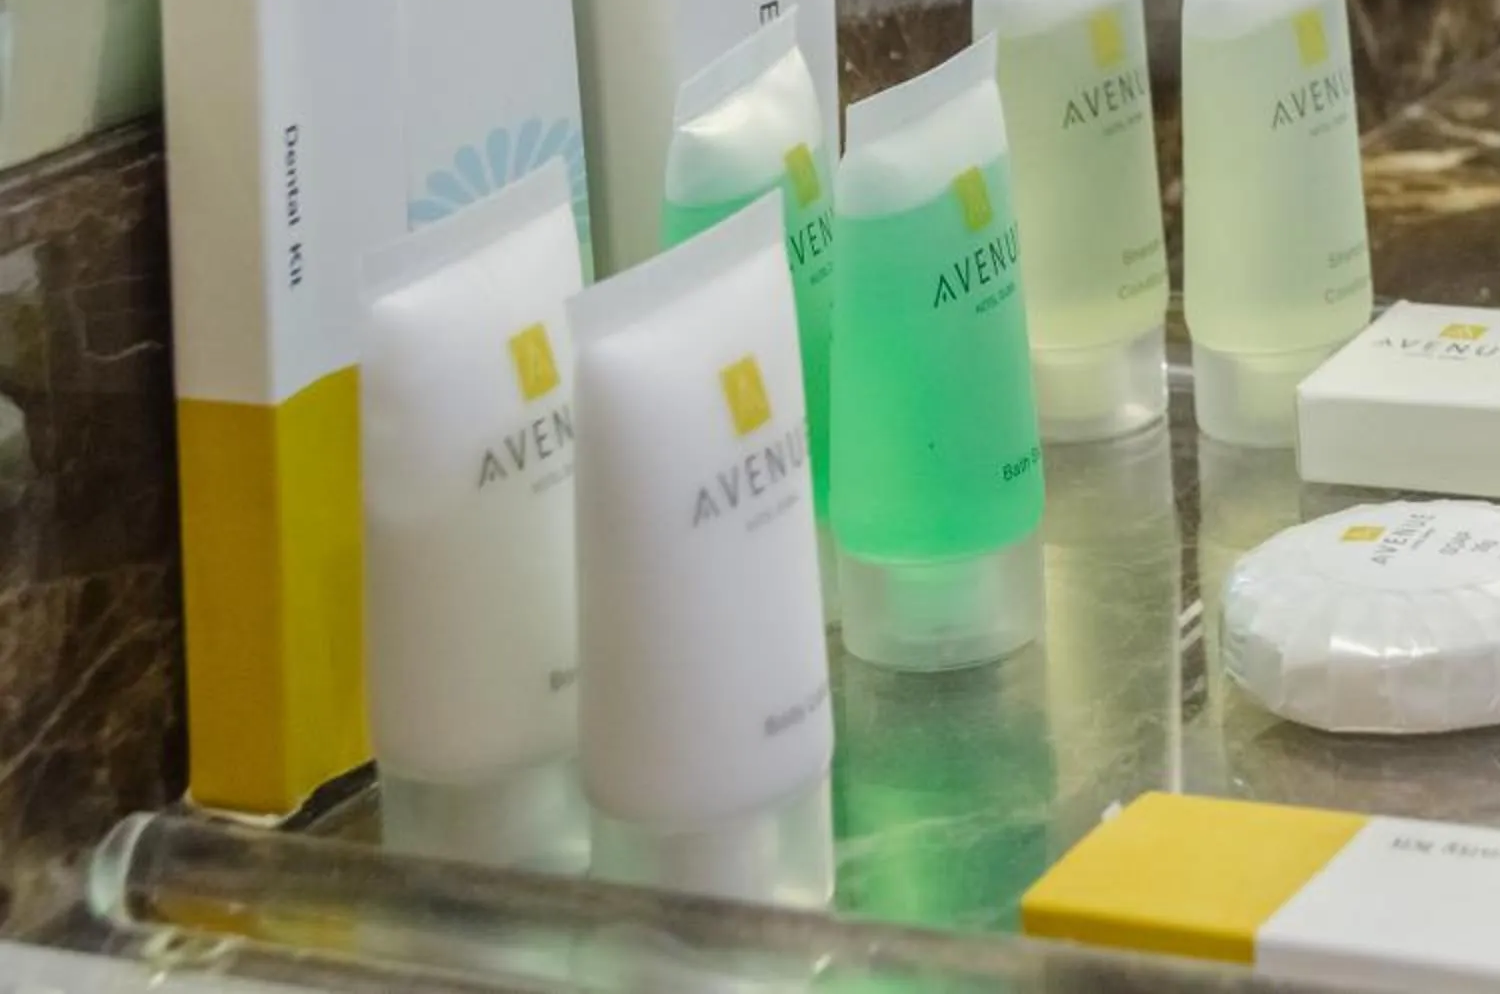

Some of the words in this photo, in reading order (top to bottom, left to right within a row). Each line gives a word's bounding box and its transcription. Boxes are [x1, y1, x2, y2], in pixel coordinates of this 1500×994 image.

[286, 125, 301, 227] Dental
[289, 242, 303, 290] Kit
[789, 206, 834, 273] VEN
[933, 221, 1018, 309] AVENU
[478, 402, 575, 490] AVEN
[693, 426, 806, 528] AVENU
